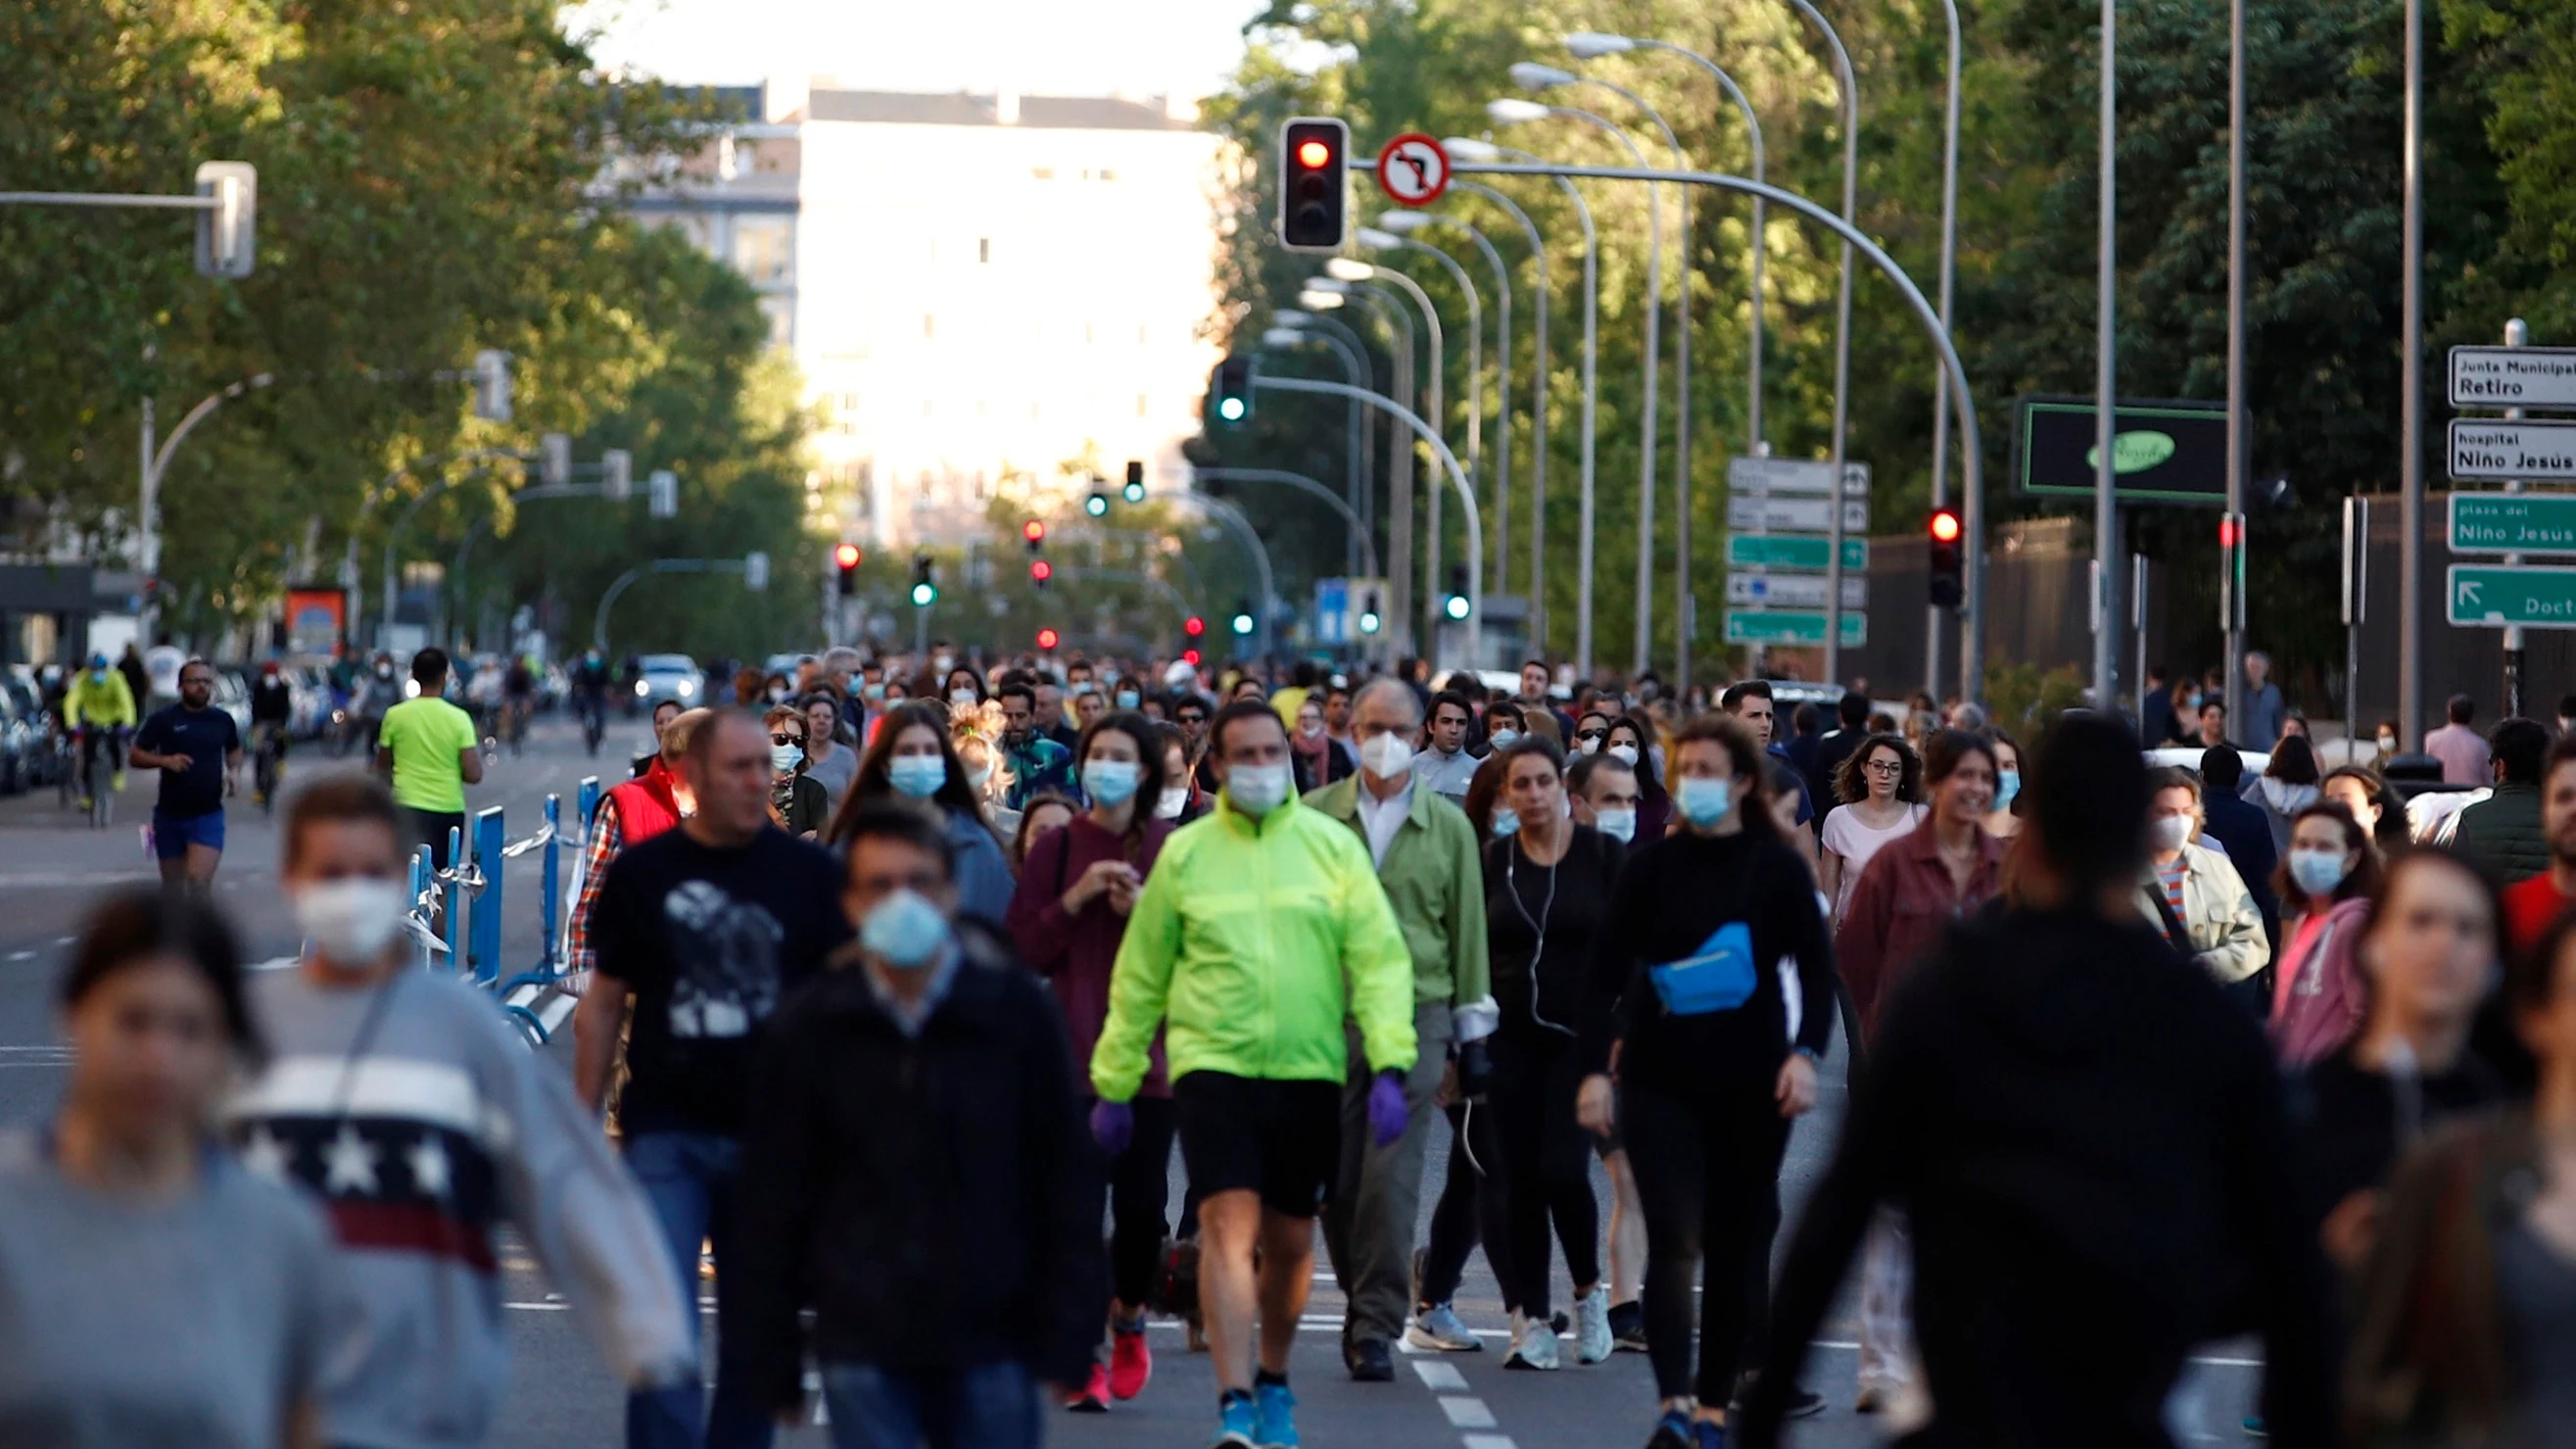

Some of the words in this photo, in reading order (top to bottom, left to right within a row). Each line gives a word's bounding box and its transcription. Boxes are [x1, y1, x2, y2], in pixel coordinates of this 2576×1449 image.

[2460, 361, 2501, 372] Junta
[2460, 378, 2523, 395] Retiro
[2458, 432, 2519, 447] hospital
[2458, 451, 2506, 467] Niño
[2516, 451, 2573, 468] Jesús
[2459, 504, 2499, 518] plaza
[2506, 504, 2528, 515] del
[2517, 523, 2574, 541] Jesús
[2525, 598, 2576, 614] Doct
